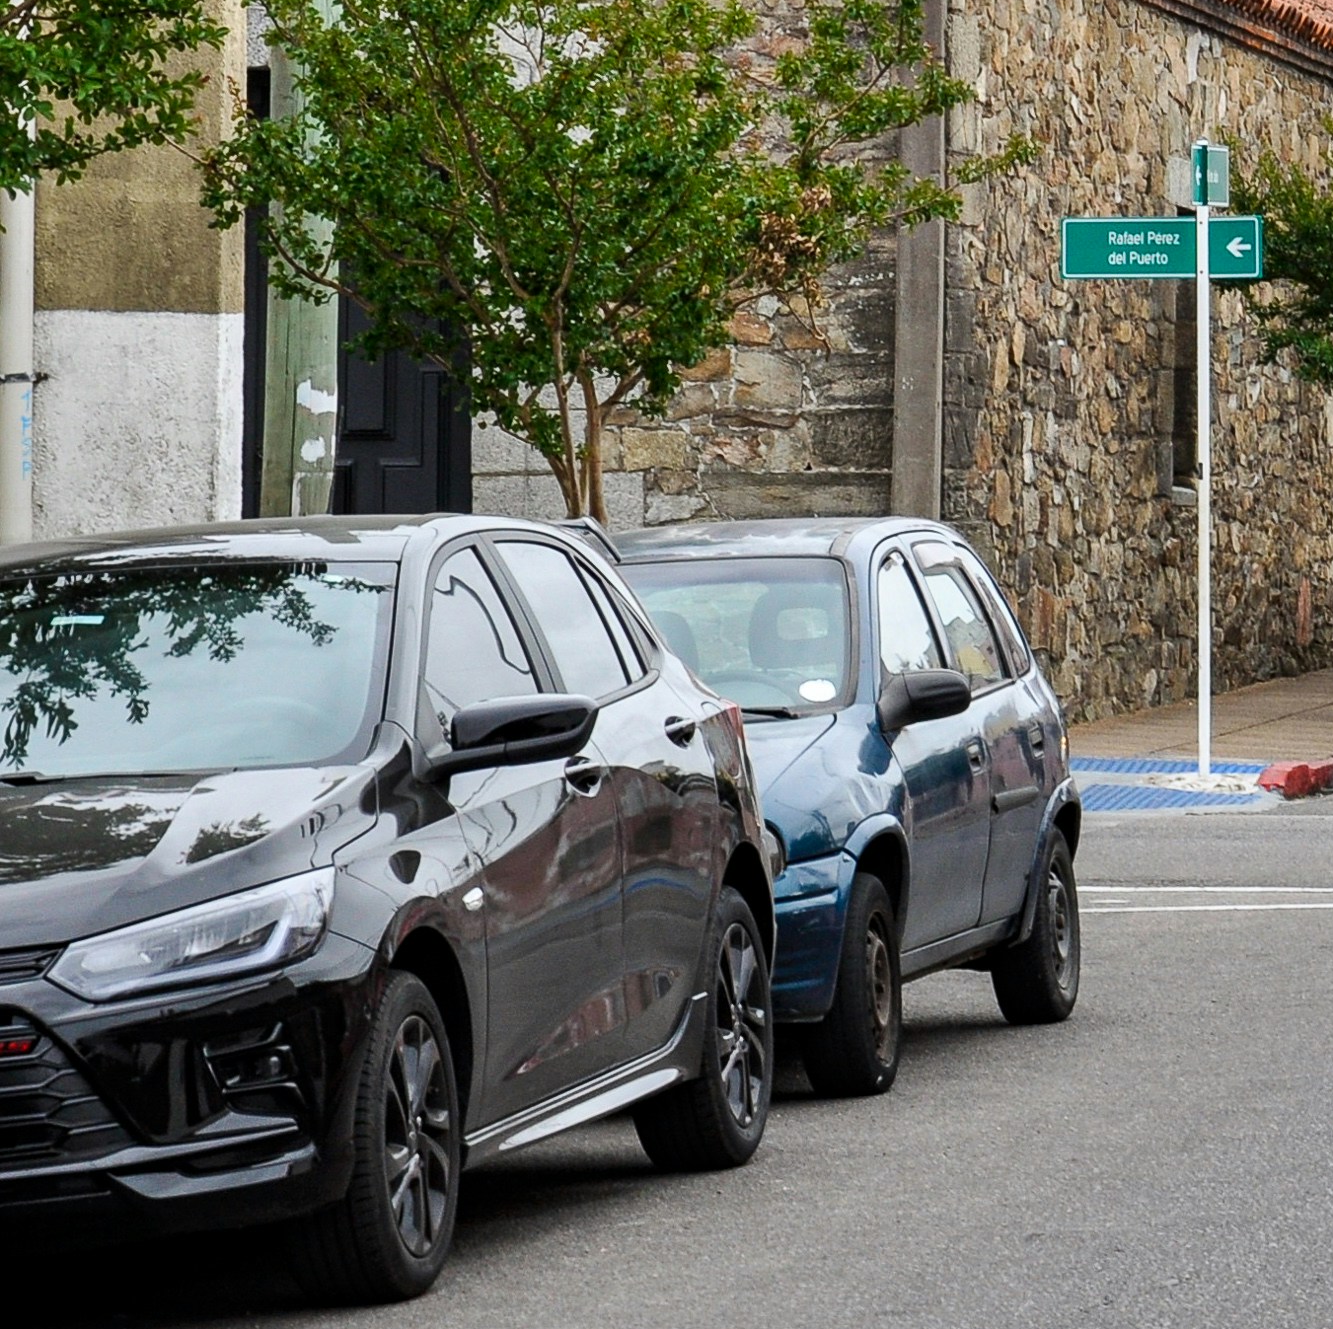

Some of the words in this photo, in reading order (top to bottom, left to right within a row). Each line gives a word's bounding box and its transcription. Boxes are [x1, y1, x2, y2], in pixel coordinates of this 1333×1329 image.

[1108, 231, 1144, 245] Rafael
[1147, 231, 1180, 245] Pérez
[1108, 251, 1126, 265] del
[1130, 251, 1168, 265] Puerto
